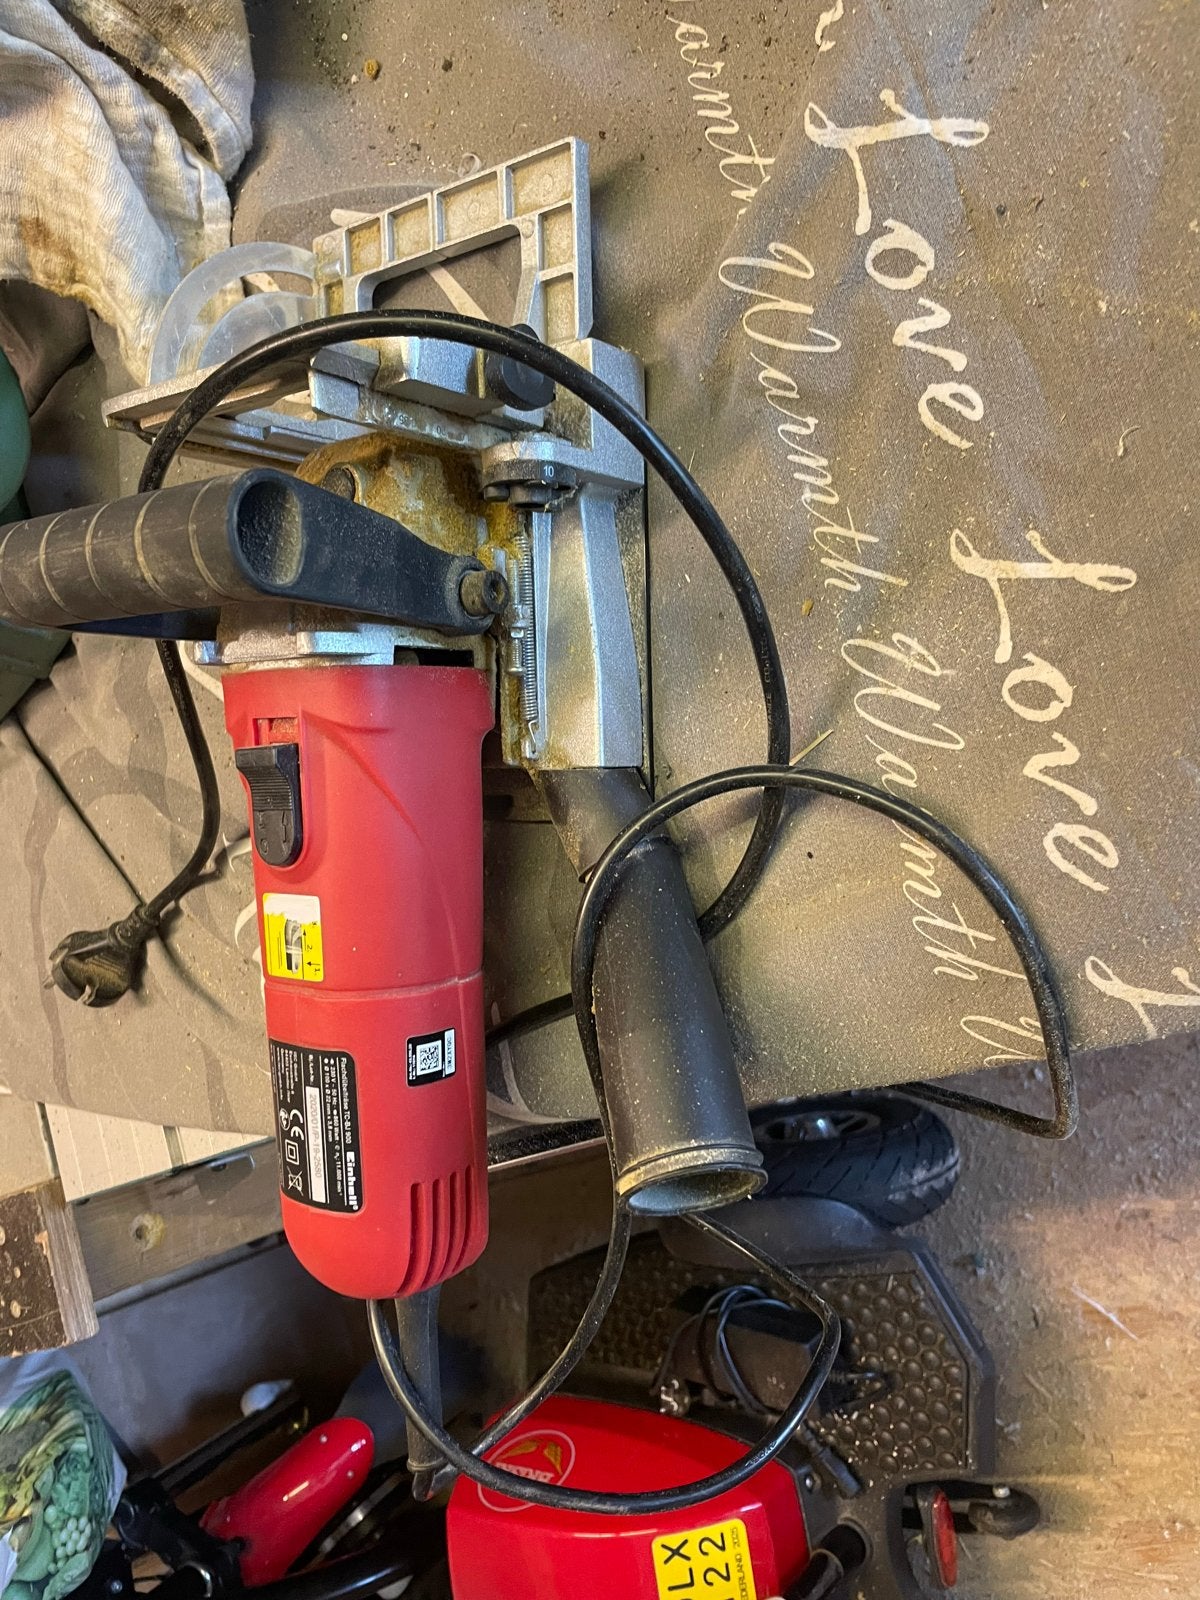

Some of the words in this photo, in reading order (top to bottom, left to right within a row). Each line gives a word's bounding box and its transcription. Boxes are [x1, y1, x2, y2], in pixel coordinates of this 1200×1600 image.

[543, 464, 555, 478] 10
[804, 88, 990, 451] Love
[950, 528, 1138, 892] Love
[719, 242, 908, 592] Warmth
[840, 632, 1028, 982] Wamth
[346, 1151, 358, 1206] Einhell
[661, 1539, 694, 1600] LX
[699, 1532, 735, 1600] 22
